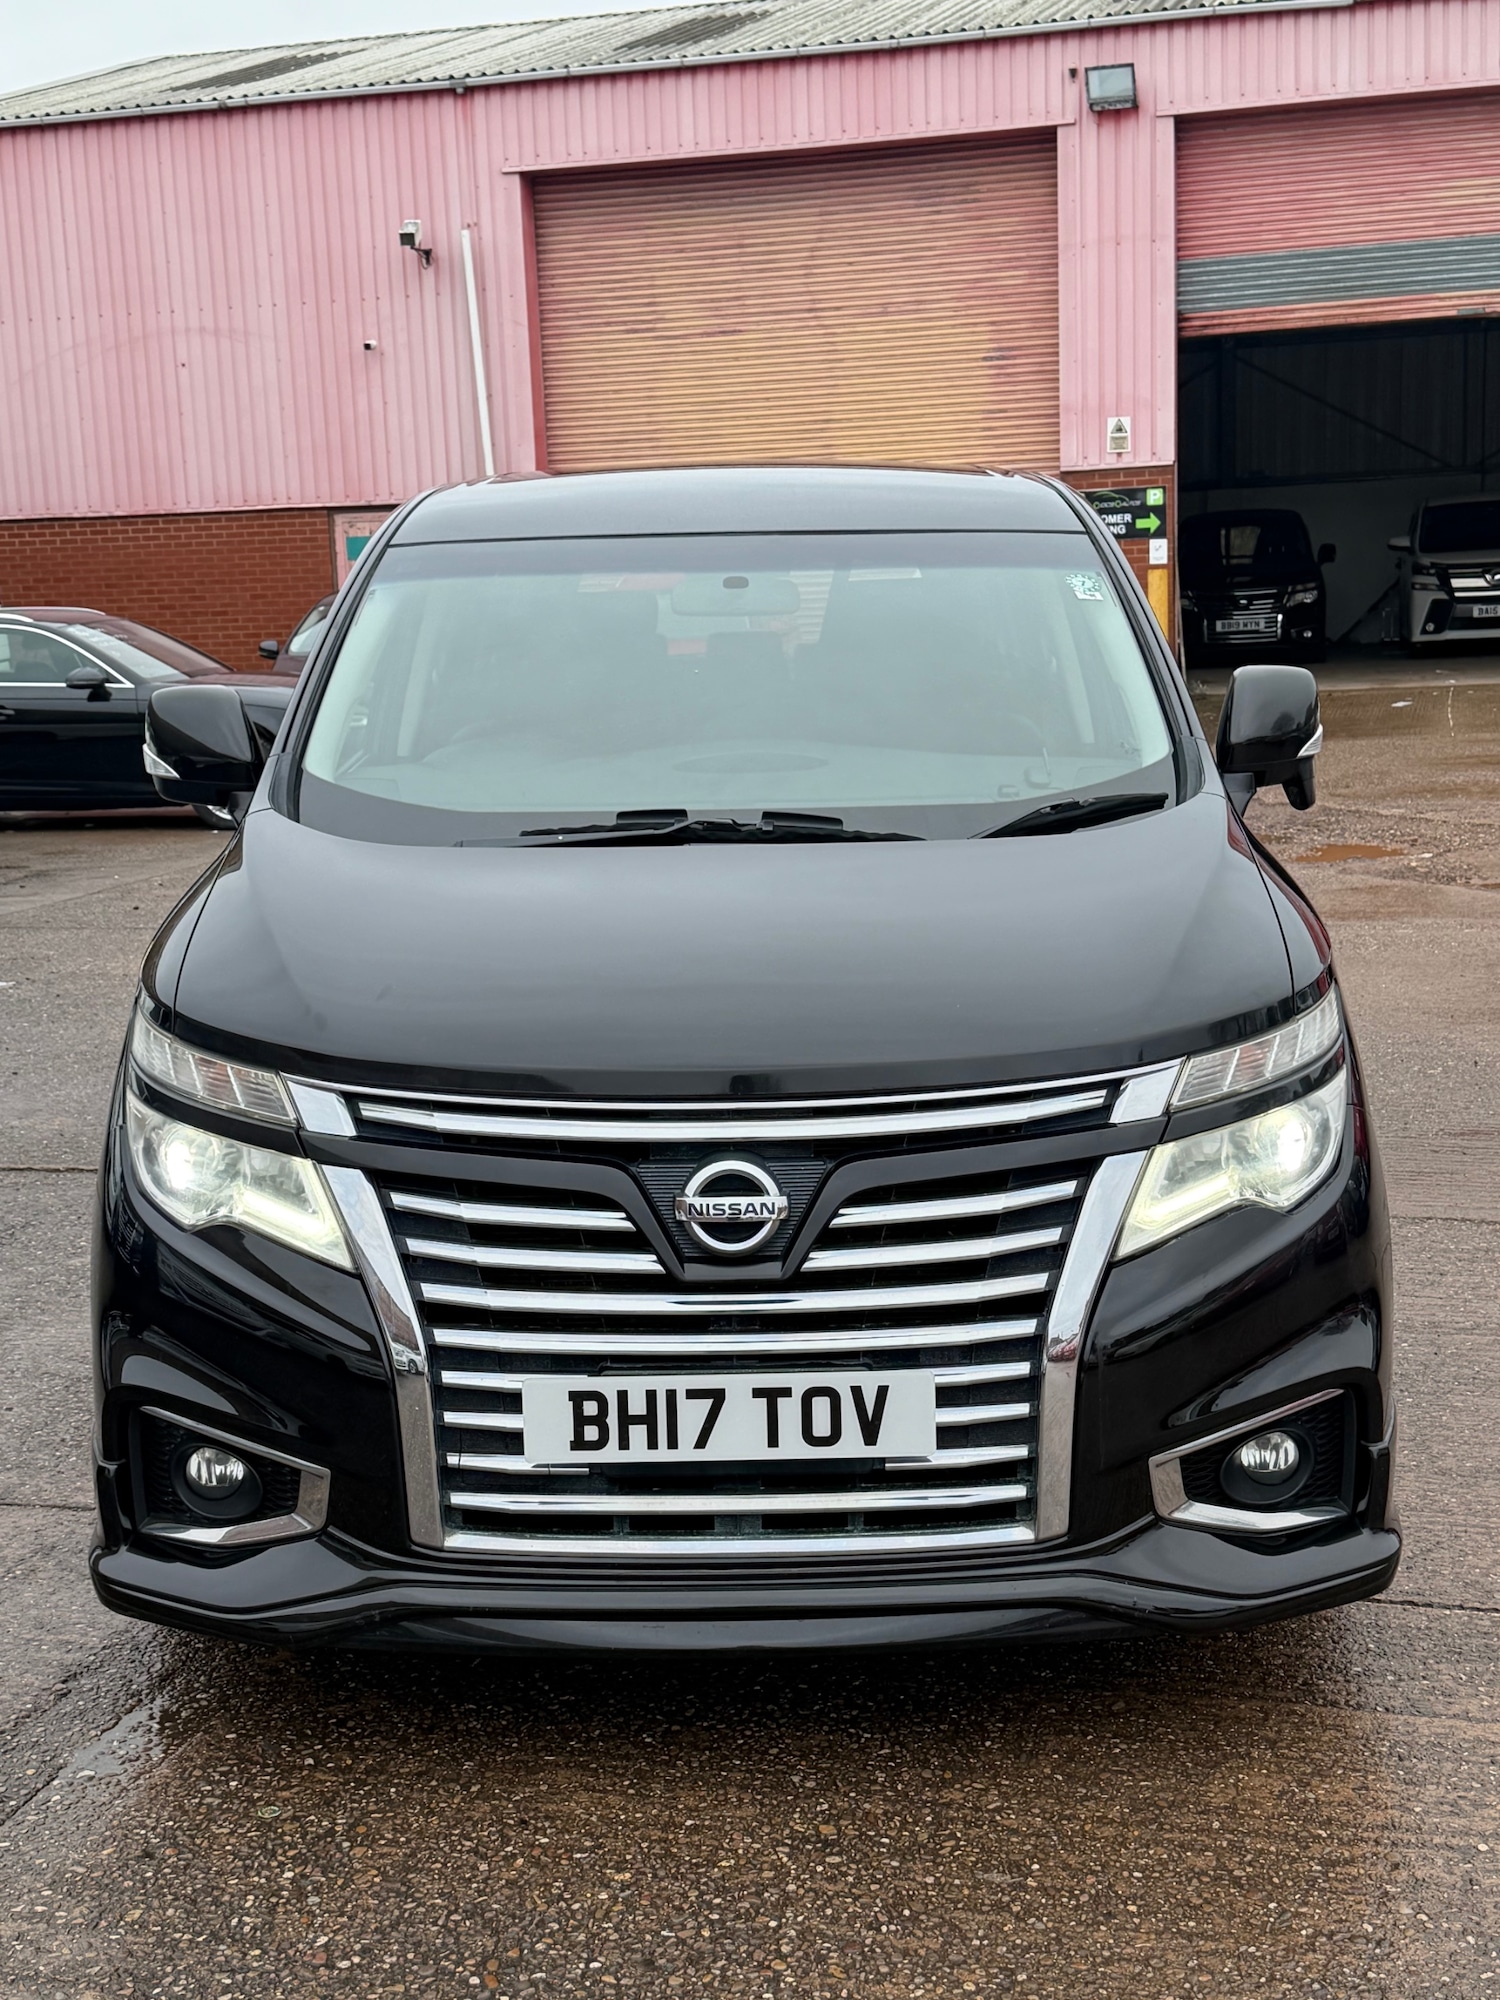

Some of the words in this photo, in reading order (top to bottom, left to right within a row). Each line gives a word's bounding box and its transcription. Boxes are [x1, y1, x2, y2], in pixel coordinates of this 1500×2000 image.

[1150, 491, 1160, 503] P
[1109, 525, 1126, 535] NG
[687, 1201, 776, 1217] NISSAN
[568, 1387, 726, 1451] BH17
[752, 1385, 890, 1448] TOV
